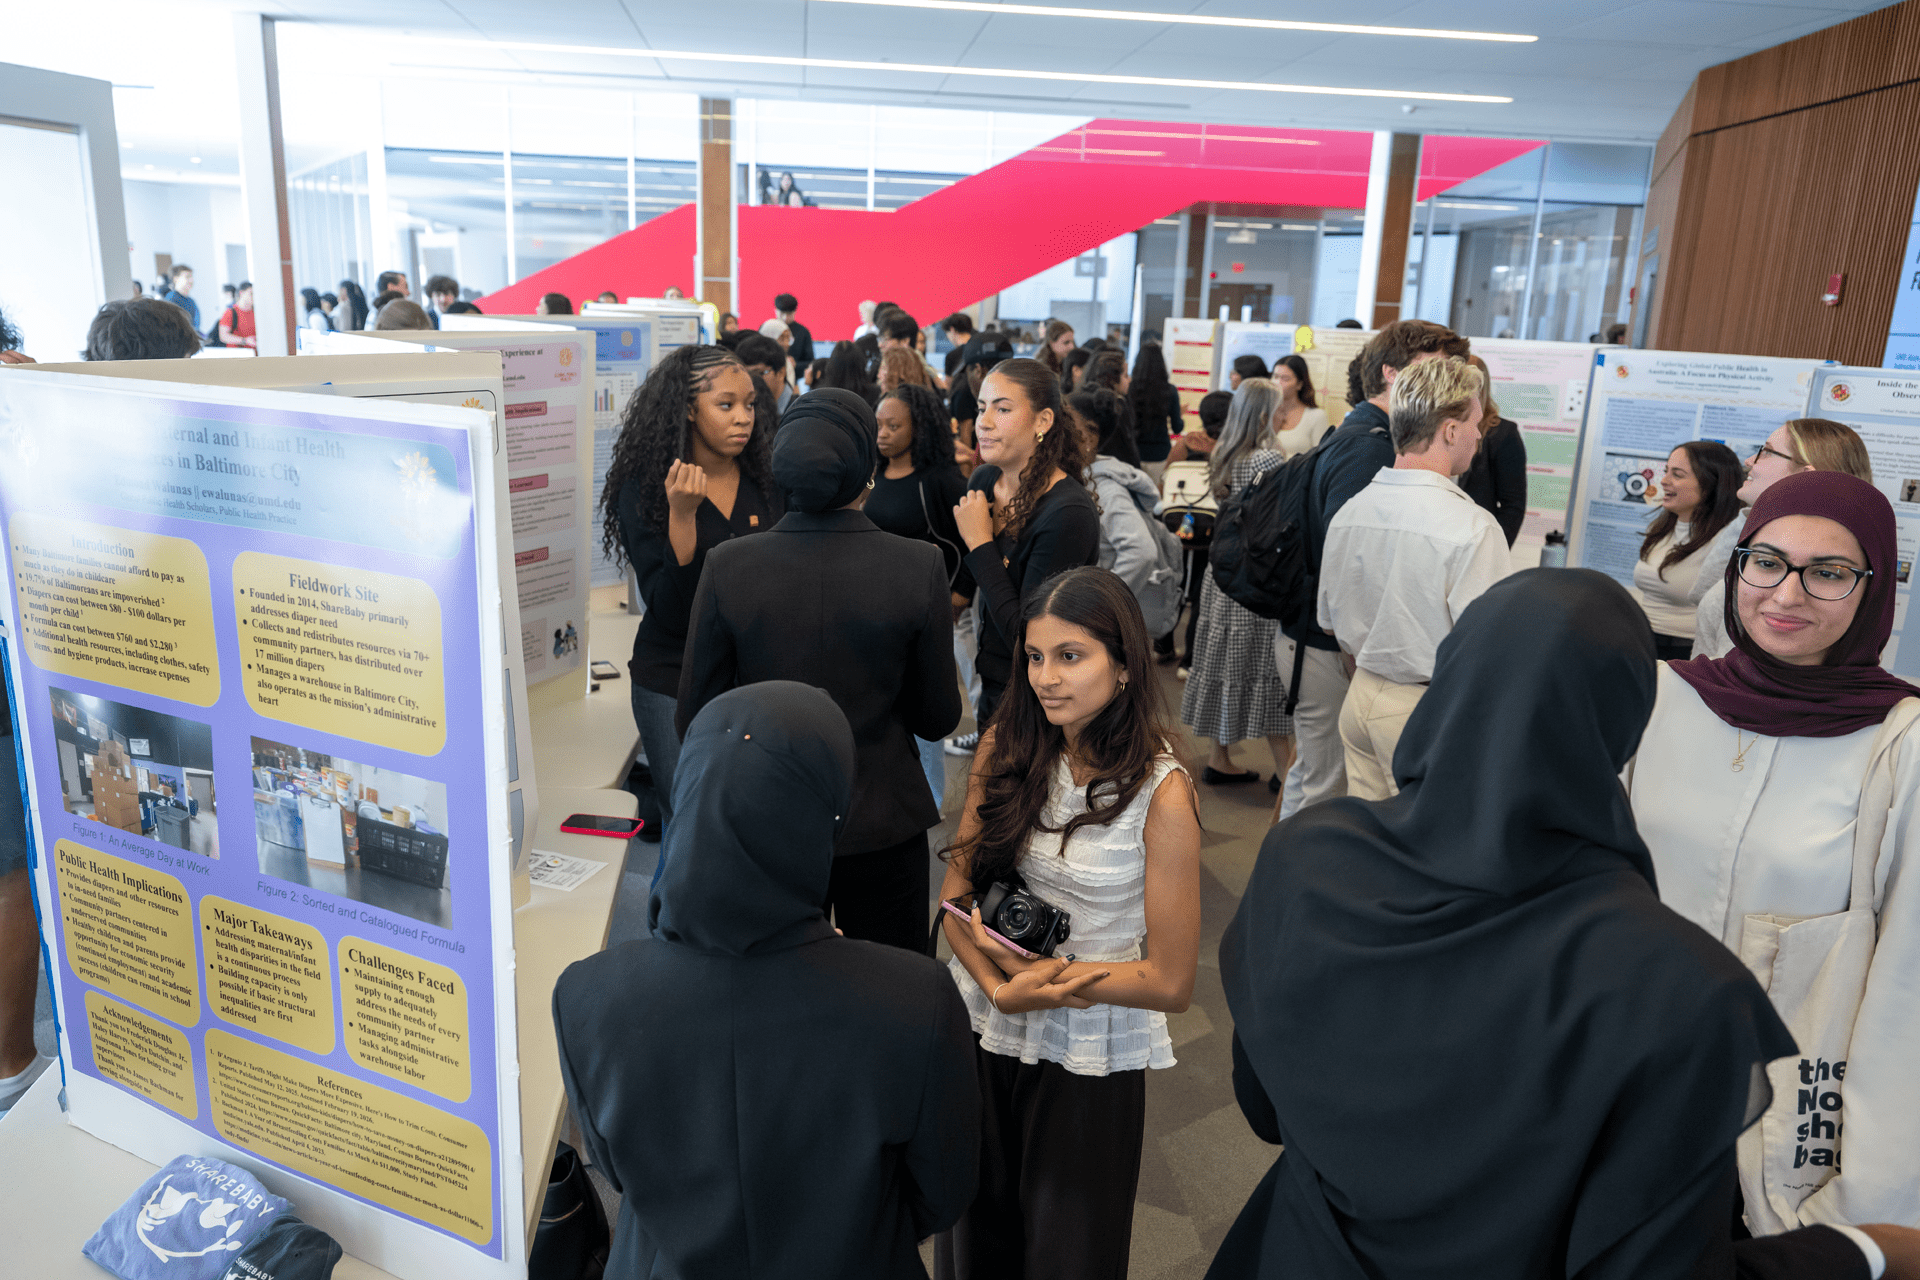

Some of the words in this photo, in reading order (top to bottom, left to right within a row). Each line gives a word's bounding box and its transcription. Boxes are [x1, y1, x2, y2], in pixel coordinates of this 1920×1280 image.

[1748, 375, 1773, 383] Activity
[1877, 380, 1902, 389] Inside
[213, 431, 240, 448] and
[244, 431, 291, 452] Infant
[295, 437, 346, 459] Health
[177, 452, 191, 469] in
[194, 453, 266, 478] Baltimore
[271, 462, 301, 487] City
[201, 488, 302, 510] ewalunas@umd.edu
[219, 506, 241, 518] Public
[243, 509, 267, 521] Health
[71, 535, 135, 558] Introduction
[289, 574, 351, 597] Fieldwork
[355, 585, 379, 602] Site
[250, 588, 285, 603] Founded
[286, 594, 295, 605] in
[297, 596, 319, 611] 2014,
[320, 600, 365, 620] ShareBaby
[368, 611, 409, 628] primarily
[250, 604, 289, 619] addresses
[290, 611, 316, 626] diaper
[318, 619, 338, 629] need
[30, 613, 58, 627] Formula
[58, 621, 71, 629] can
[71, 624, 86, 633] cost
[86, 625, 115, 639] between
[115, 631, 133, 643] $760
[134, 636, 148, 646] and
[149, 638, 173, 651] $2,280
[252, 618, 284, 633] Collects
[285, 626, 301, 637] and
[302, 629, 354, 647] redistributes
[356, 641, 396, 655] resources
[398, 647, 411, 658] via
[414, 649, 430, 661] 70+
[253, 636, 297, 654] community
[299, 645, 336, 661] partners,
[338, 651, 352, 663] has
[354, 654, 401, 673] distributed
[403, 667, 423, 677] over
[255, 648, 263, 659] 17
[265, 652, 294, 665] million
[295, 657, 325, 672] diapers
[256, 663, 291, 681] Manages
[292, 673, 297, 681] a
[299, 675, 341, 691] warehouse
[343, 682, 351, 693] in
[353, 684, 395, 702] Baltimore
[397, 694, 419, 710] City,
[257, 679, 273, 691] also
[273, 685, 307, 698] operates
[308, 692, 317, 701] as
[318, 693, 331, 704] the
[373, 705, 437, 727] administrative
[258, 693, 279, 706] heart
[73, 822, 97, 839] Figure
[100, 830, 107, 842] 1:
[108, 833, 120, 846] An
[120, 837, 155, 859] Average
[156, 849, 174, 867] Day
[175, 858, 185, 868] at
[186, 859, 210, 876] Work
[59, 850, 87, 870] Public
[88, 860, 120, 881] Health
[122, 871, 183, 903] Implications
[66, 869, 91, 885] Provides
[92, 878, 115, 893] diapers
[115, 888, 128, 898] and
[129, 893, 146, 904] other
[147, 899, 179, 916] resources
[213, 908, 247, 929] Major
[250, 920, 313, 951] Takeaways
[257, 880, 287, 899] Figure
[290, 890, 299, 903] 2:
[301, 894, 335, 914] Sorted
[337, 907, 357, 920] and
[359, 911, 418, 939] Catalogued
[420, 930, 465, 953] Formula
[215, 926, 255, 949] Addressing
[257, 941, 317, 965] maternal/infant
[215, 939, 238, 954] health
[239, 946, 279, 967] disparities
[280, 959, 288, 969] in
[289, 963, 301, 974] the
[303, 966, 321, 980] field
[217, 951, 223, 961] is
[230, 958, 271, 977] continuous
[272, 971, 300, 986] process
[218, 965, 249, 985] Building
[250, 977, 281, 995] capacity
[283, 985, 290, 995] is
[291, 990, 308, 1003] only
[348, 949, 414, 982] Challenges
[417, 971, 454, 994] Faced
[219, 980, 247, 995] possible
[249, 987, 255, 997] if
[256, 990, 275, 1004] basic
[277, 999, 315, 1017] structural
[354, 969, 403, 995] Maintaining
[405, 988, 435, 1004] enough
[355, 984, 381, 1001] supply
[383, 992, 392, 1002] to
[393, 996, 438, 1019] adequately
[220, 991, 261, 1012] inequalities
[262, 1007, 275, 1017] are
[277, 1009, 293, 1023] first
[220, 1005, 257, 1024] addressed
[356, 997, 387, 1014] address
[388, 1007, 401, 1019] the
[403, 1014, 426, 1027] needs
[427, 1021, 436, 1030] of
[437, 1025, 461, 1041] every
[102, 1006, 173, 1044] Acknowledgements
[357, 1011, 401, 1035] community
[404, 1027, 436, 1044] partner
[358, 1023, 398, 1048] Managing
[400, 1040, 459, 1067] administrative
[359, 1038, 379, 1051] tasks
[381, 1045, 419, 1065] alongside
[360, 1051, 402, 1072] warehouse
[403, 1065, 425, 1081] labor
[1798, 1057, 1847, 1085] the
[317, 1077, 363, 1099] References
[185, 1159, 275, 1218] SHAREBABY
